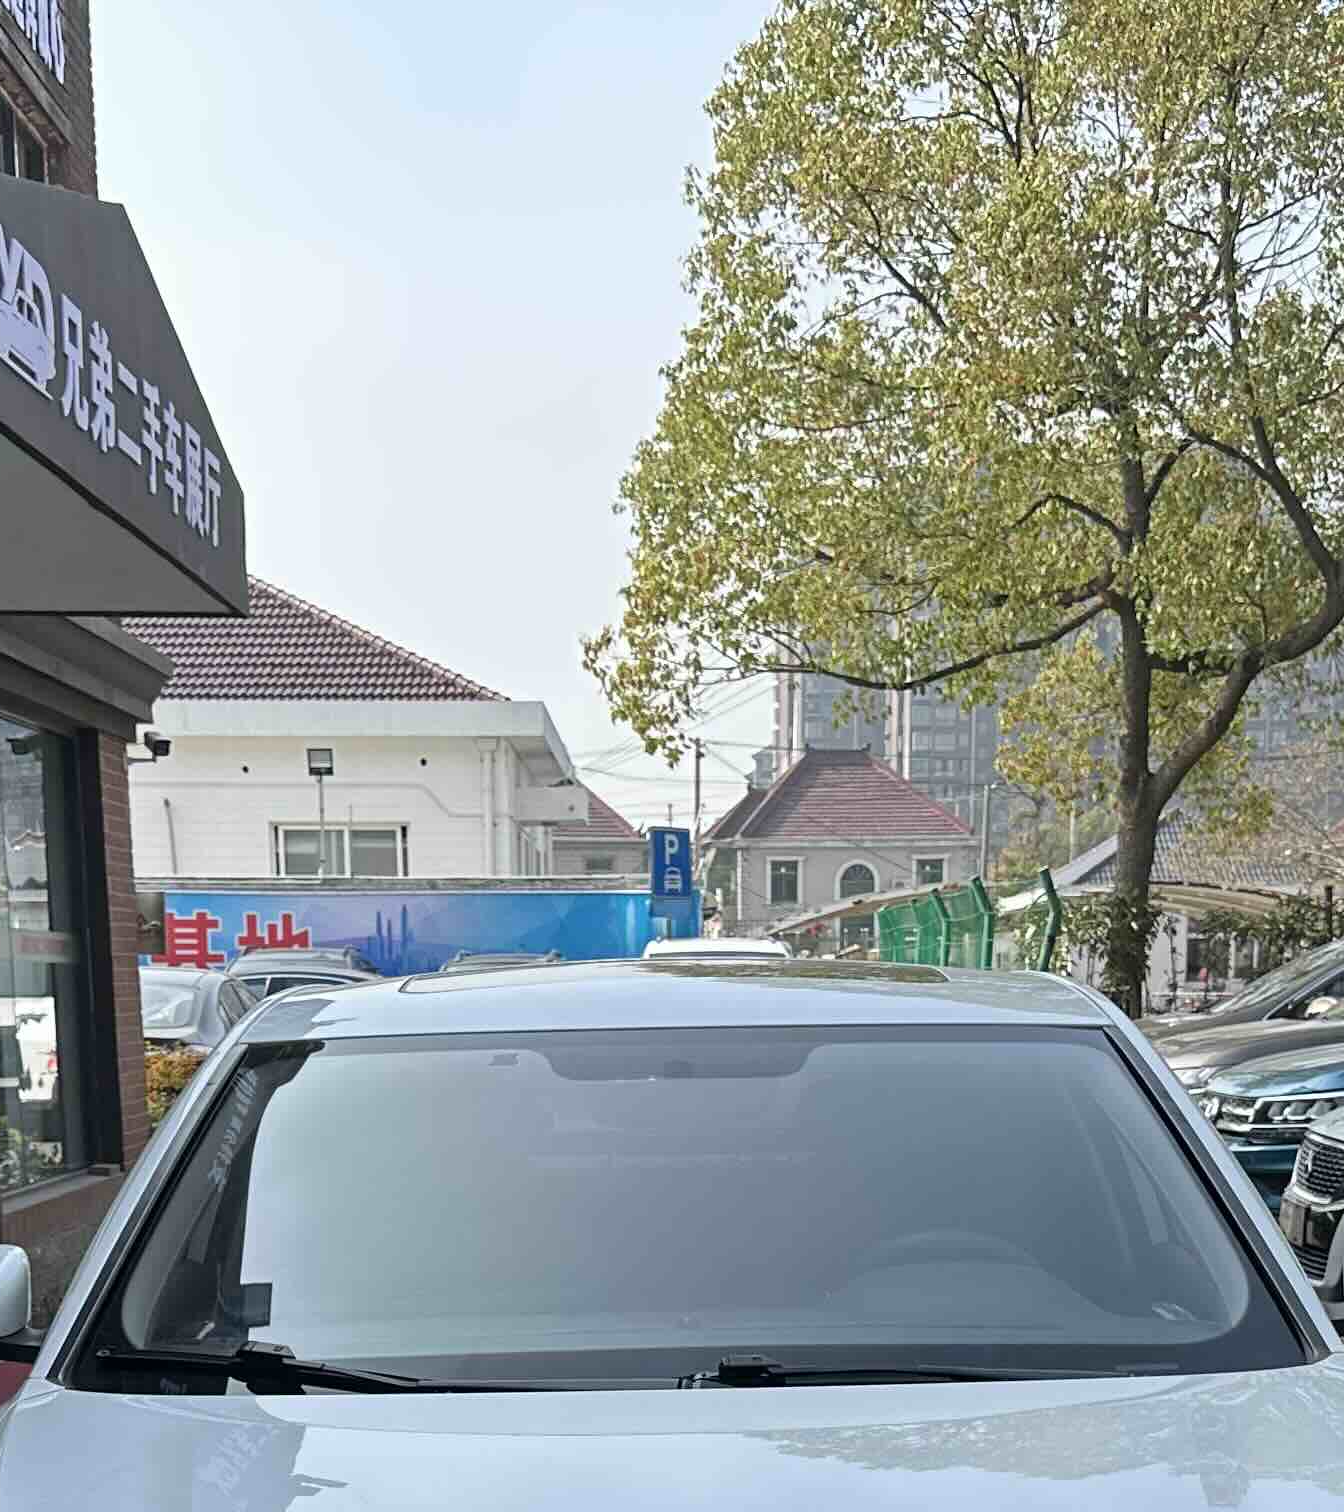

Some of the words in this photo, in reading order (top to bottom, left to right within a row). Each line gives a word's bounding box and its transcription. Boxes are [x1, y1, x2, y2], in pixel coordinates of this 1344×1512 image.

[60, 293, 221, 547] 兄弟二手车展厅
[664, 833, 679, 865] P
